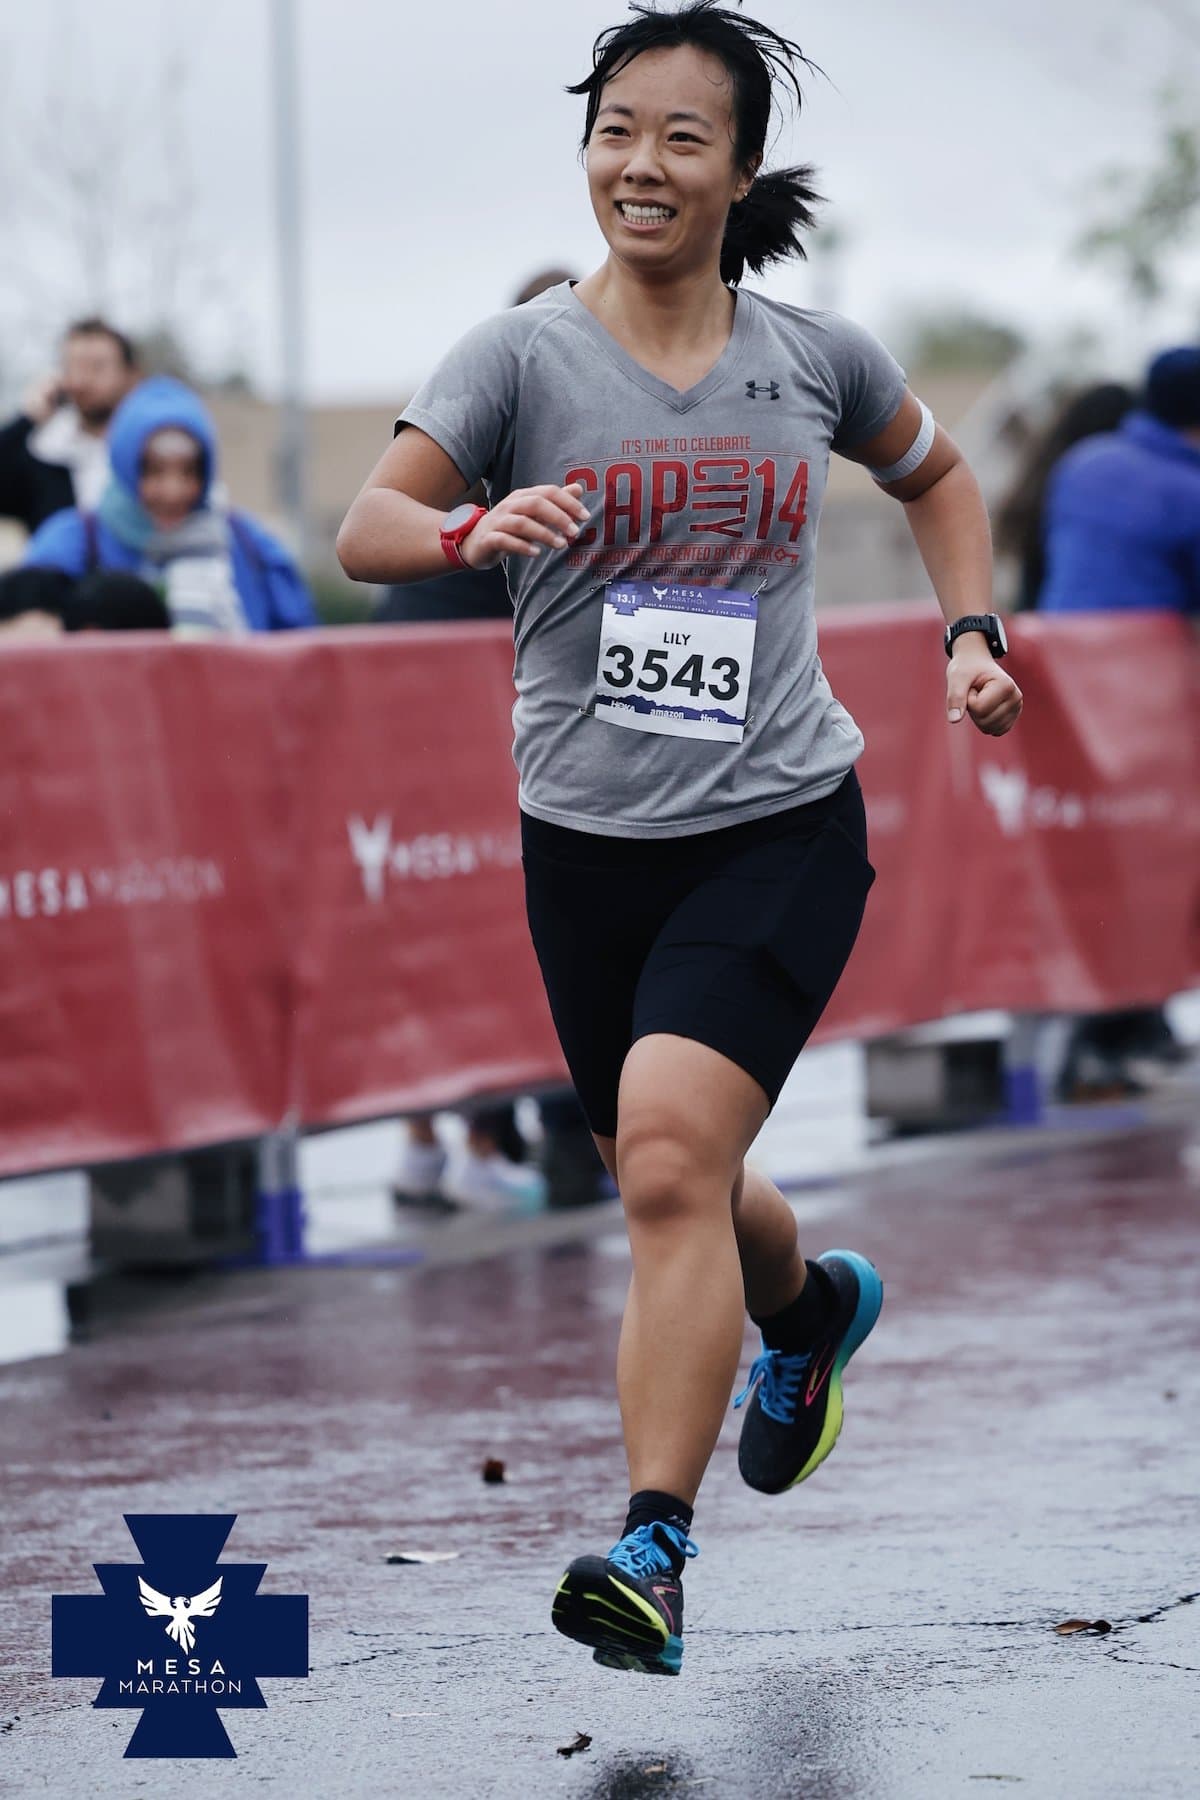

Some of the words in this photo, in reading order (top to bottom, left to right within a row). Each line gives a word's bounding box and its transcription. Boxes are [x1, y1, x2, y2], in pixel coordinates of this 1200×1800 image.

[621, 439, 641, 454] IT'S
[644, 439, 670, 453] TIME
[673, 438, 687, 452] TO
[691, 435, 751, 451] CELEBRATE
[564, 459, 689, 546] CAP
[689, 457, 750, 539] CITY
[754, 457, 809, 543] 14
[714, 545, 727, 561] BY
[616, 593, 636, 604] 13.1
[664, 596, 708, 605] MARATHON
[671, 589, 703, 599] MESA
[663, 631, 692, 646] LILY
[602, 645, 741, 701] 3543
[649, 708, 685, 720] amazon
